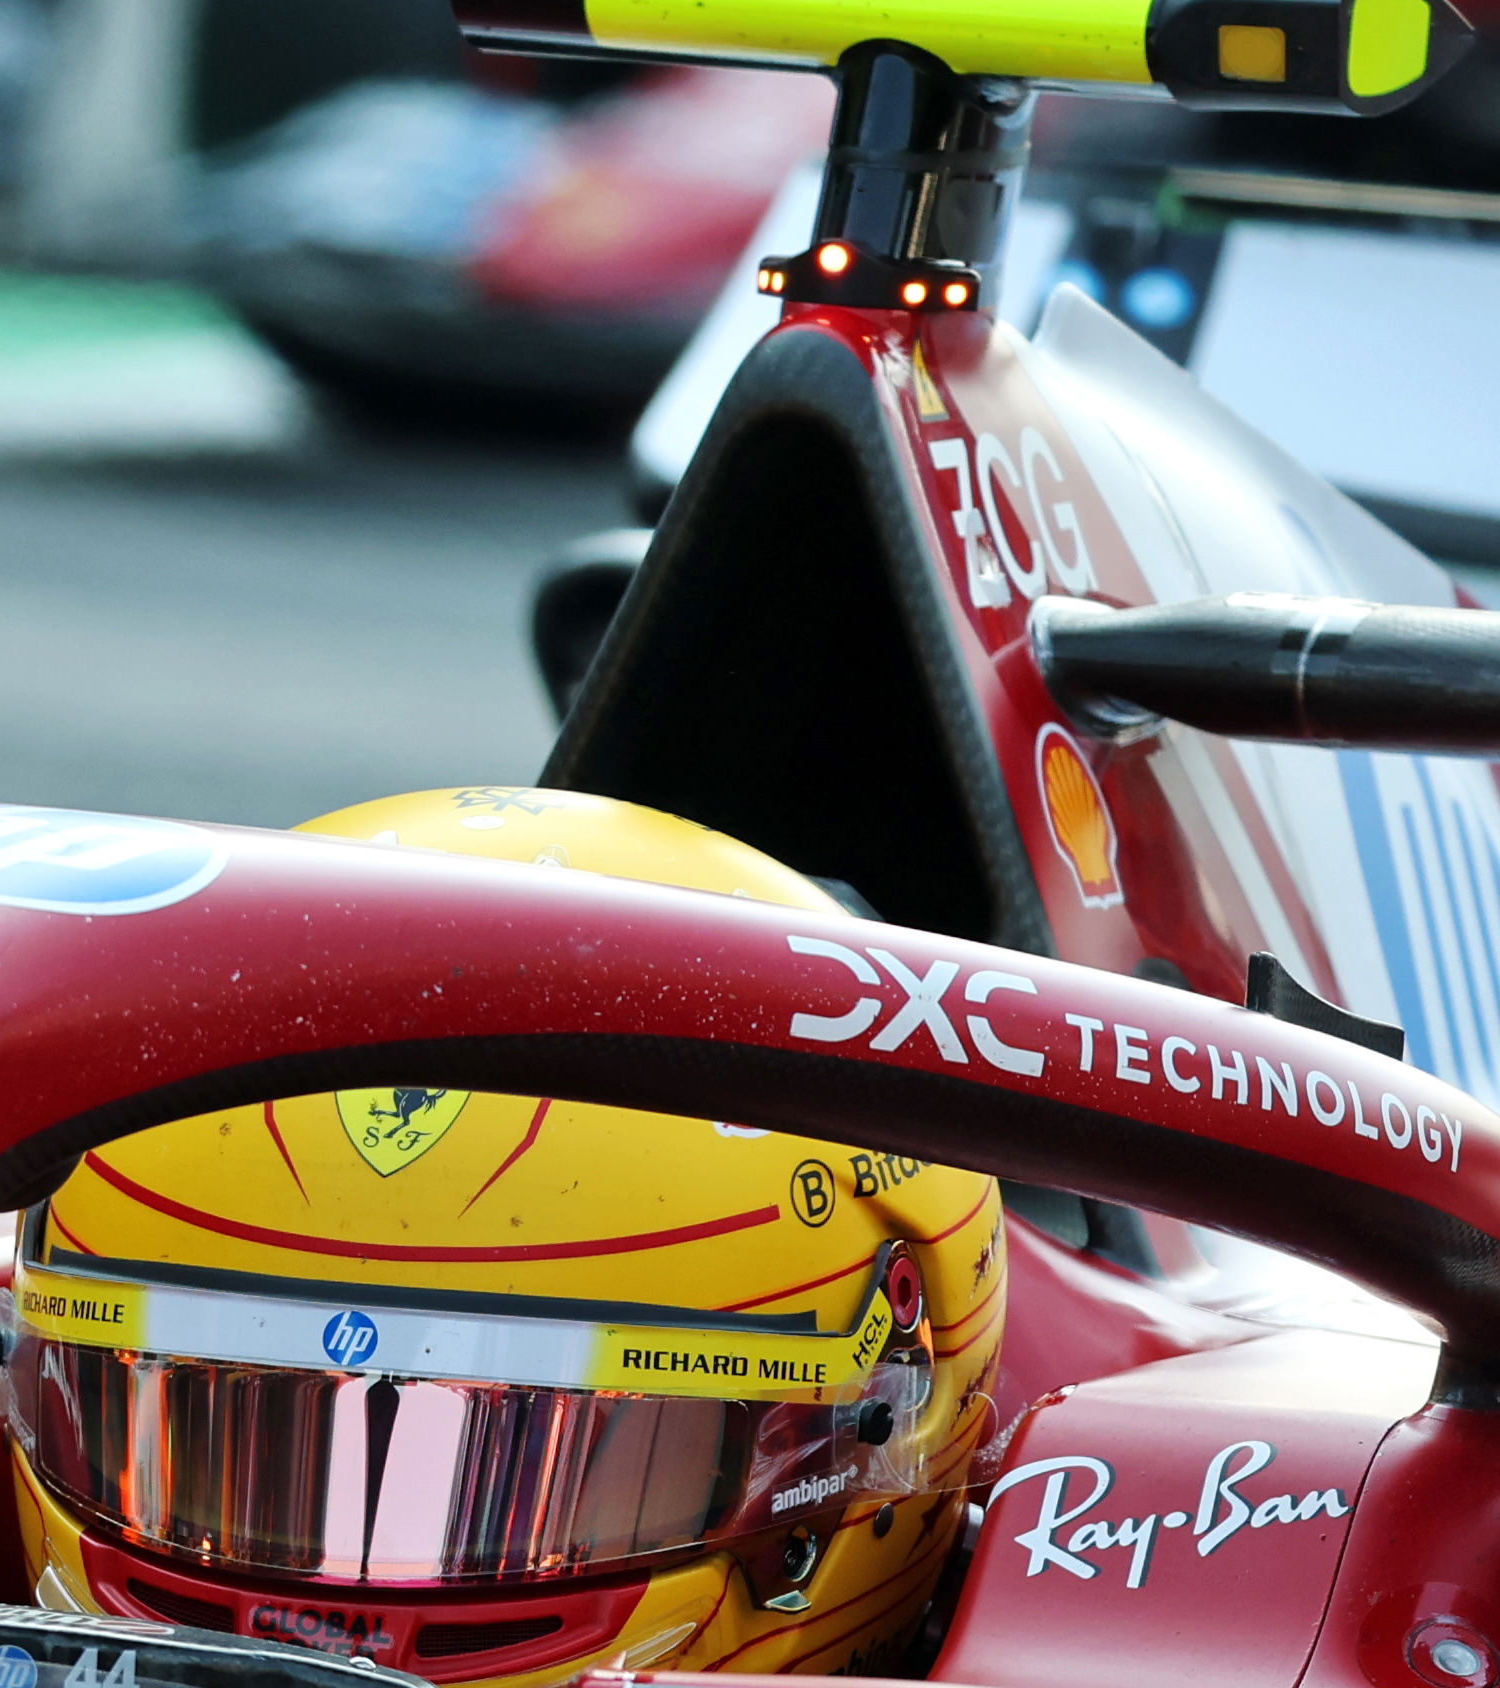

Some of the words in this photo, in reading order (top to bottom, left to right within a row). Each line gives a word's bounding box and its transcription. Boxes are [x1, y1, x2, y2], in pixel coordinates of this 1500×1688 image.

[787, 935, 1048, 1078] DXC
[1064, 1012, 1463, 1174] TECHNOLOGY
[23, 1290, 67, 1319] RICHARD
[70, 1301, 126, 1325] MILLE
[329, 1311, 375, 1366] hp
[852, 1313, 886, 1369] HCL
[621, 1348, 749, 1377] RICHARD
[758, 1358, 828, 1384] MILLE
[252, 1605, 393, 1644] GLOBAL
